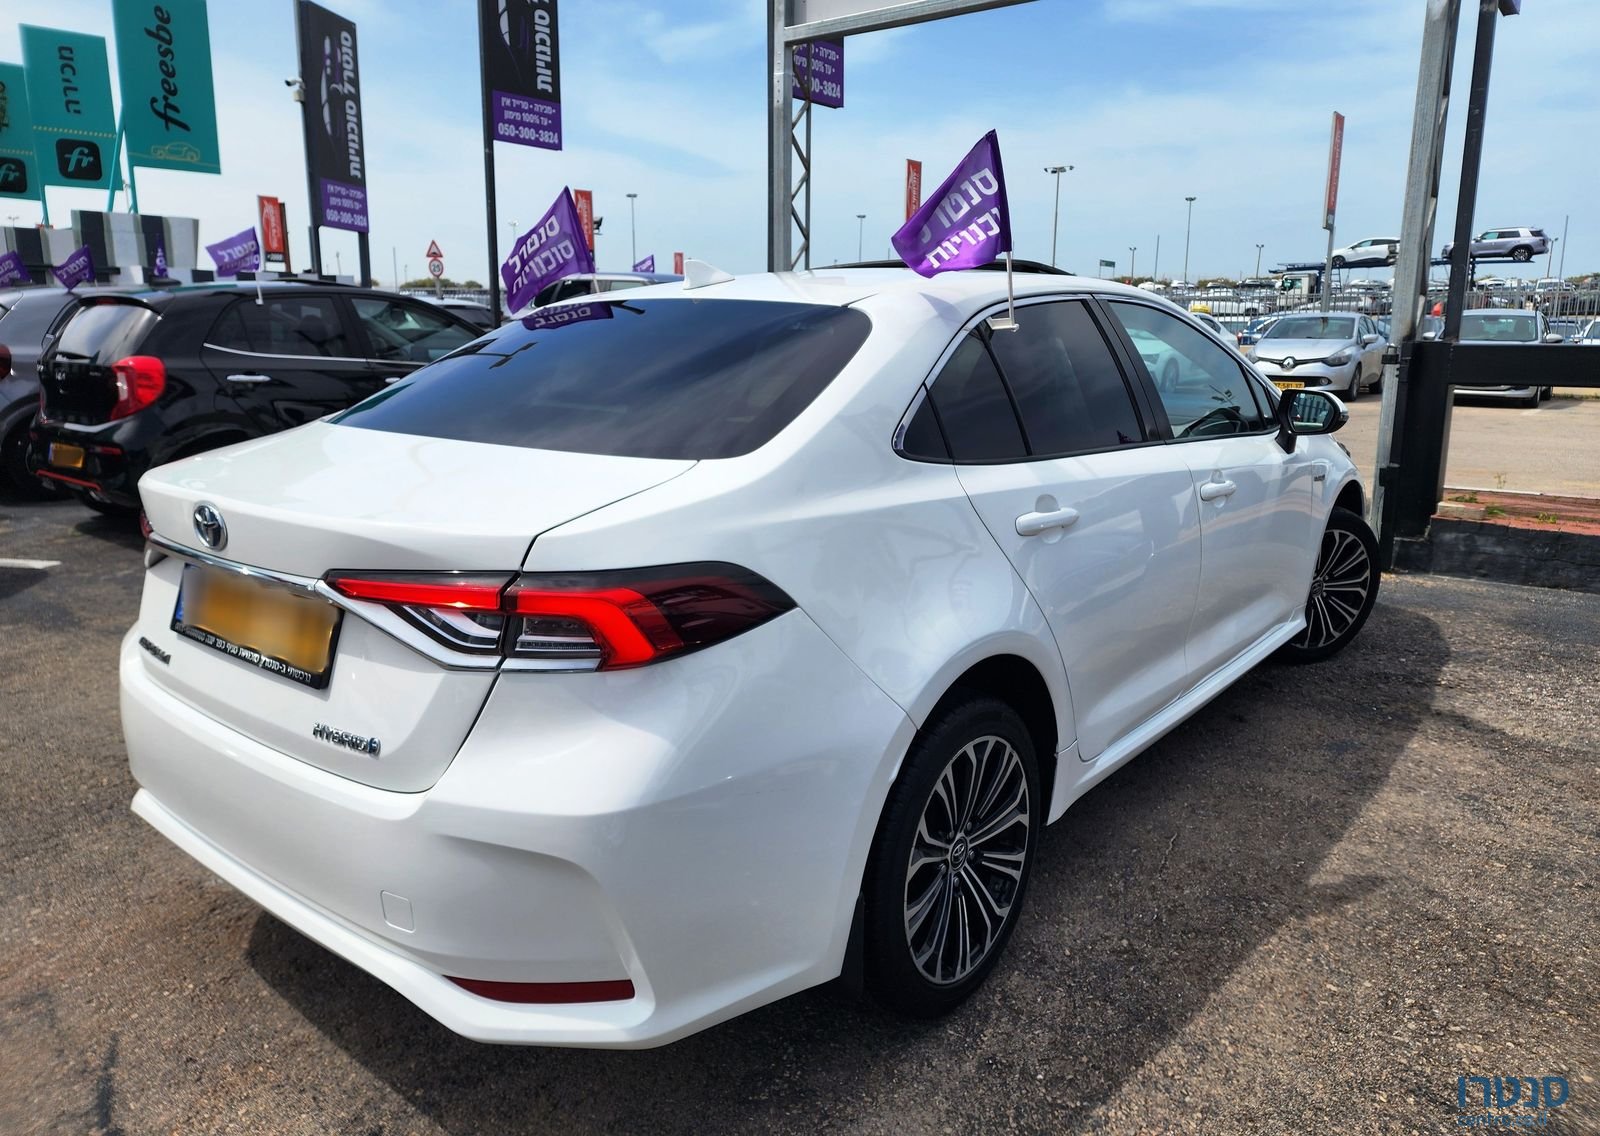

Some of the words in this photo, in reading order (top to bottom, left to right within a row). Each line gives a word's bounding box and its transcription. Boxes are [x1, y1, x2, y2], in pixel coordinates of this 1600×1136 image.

[57, 45, 82, 115] מכירה
[144, 5, 191, 132] freesbe
[534, 9, 553, 93] סוכנויות
[64, 147, 94, 172] fr
[345, 99, 361, 178] סוכנויות
[498, 122, 559, 144] 050-300-3824
[508, 215, 560, 274] סנטרל
[512, 240, 575, 295] סוכנויות
[926, 206, 1000, 269] וכנויות
[312, 722, 368, 752] HYBRID
